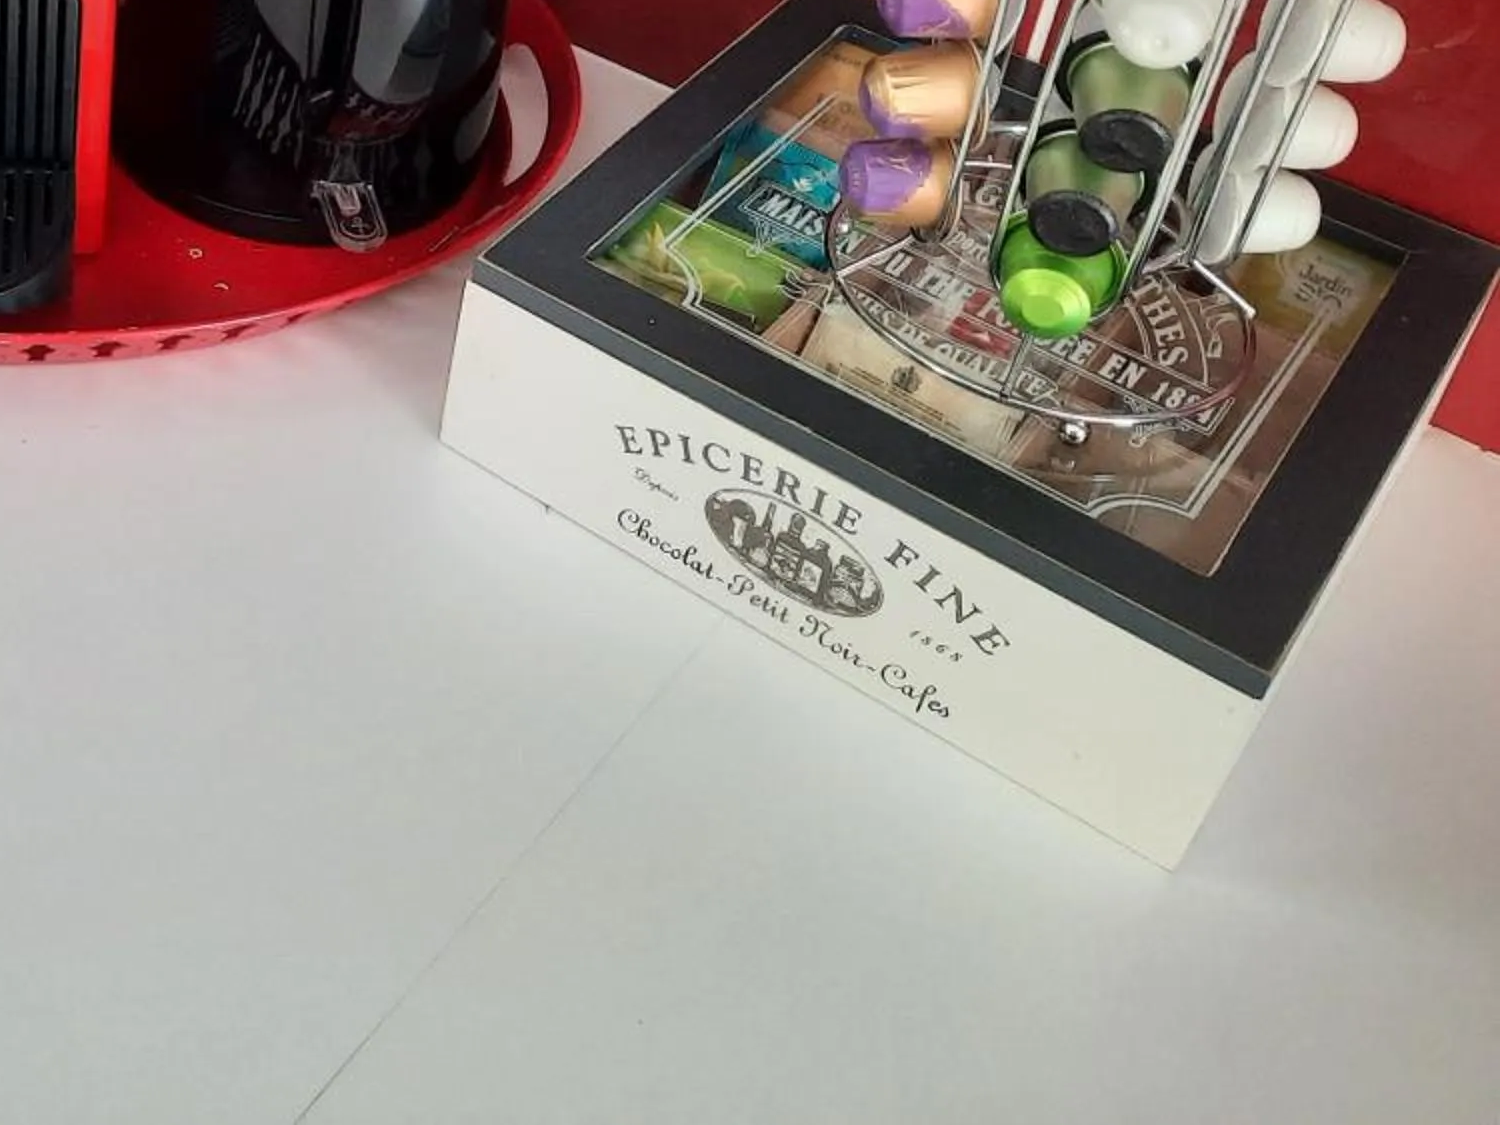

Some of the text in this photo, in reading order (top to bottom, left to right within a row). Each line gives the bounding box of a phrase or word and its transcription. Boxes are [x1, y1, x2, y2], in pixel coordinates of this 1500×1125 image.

[1099, 354, 1148, 389] EN
[615, 424, 1012, 656] EPICERIE FINE
